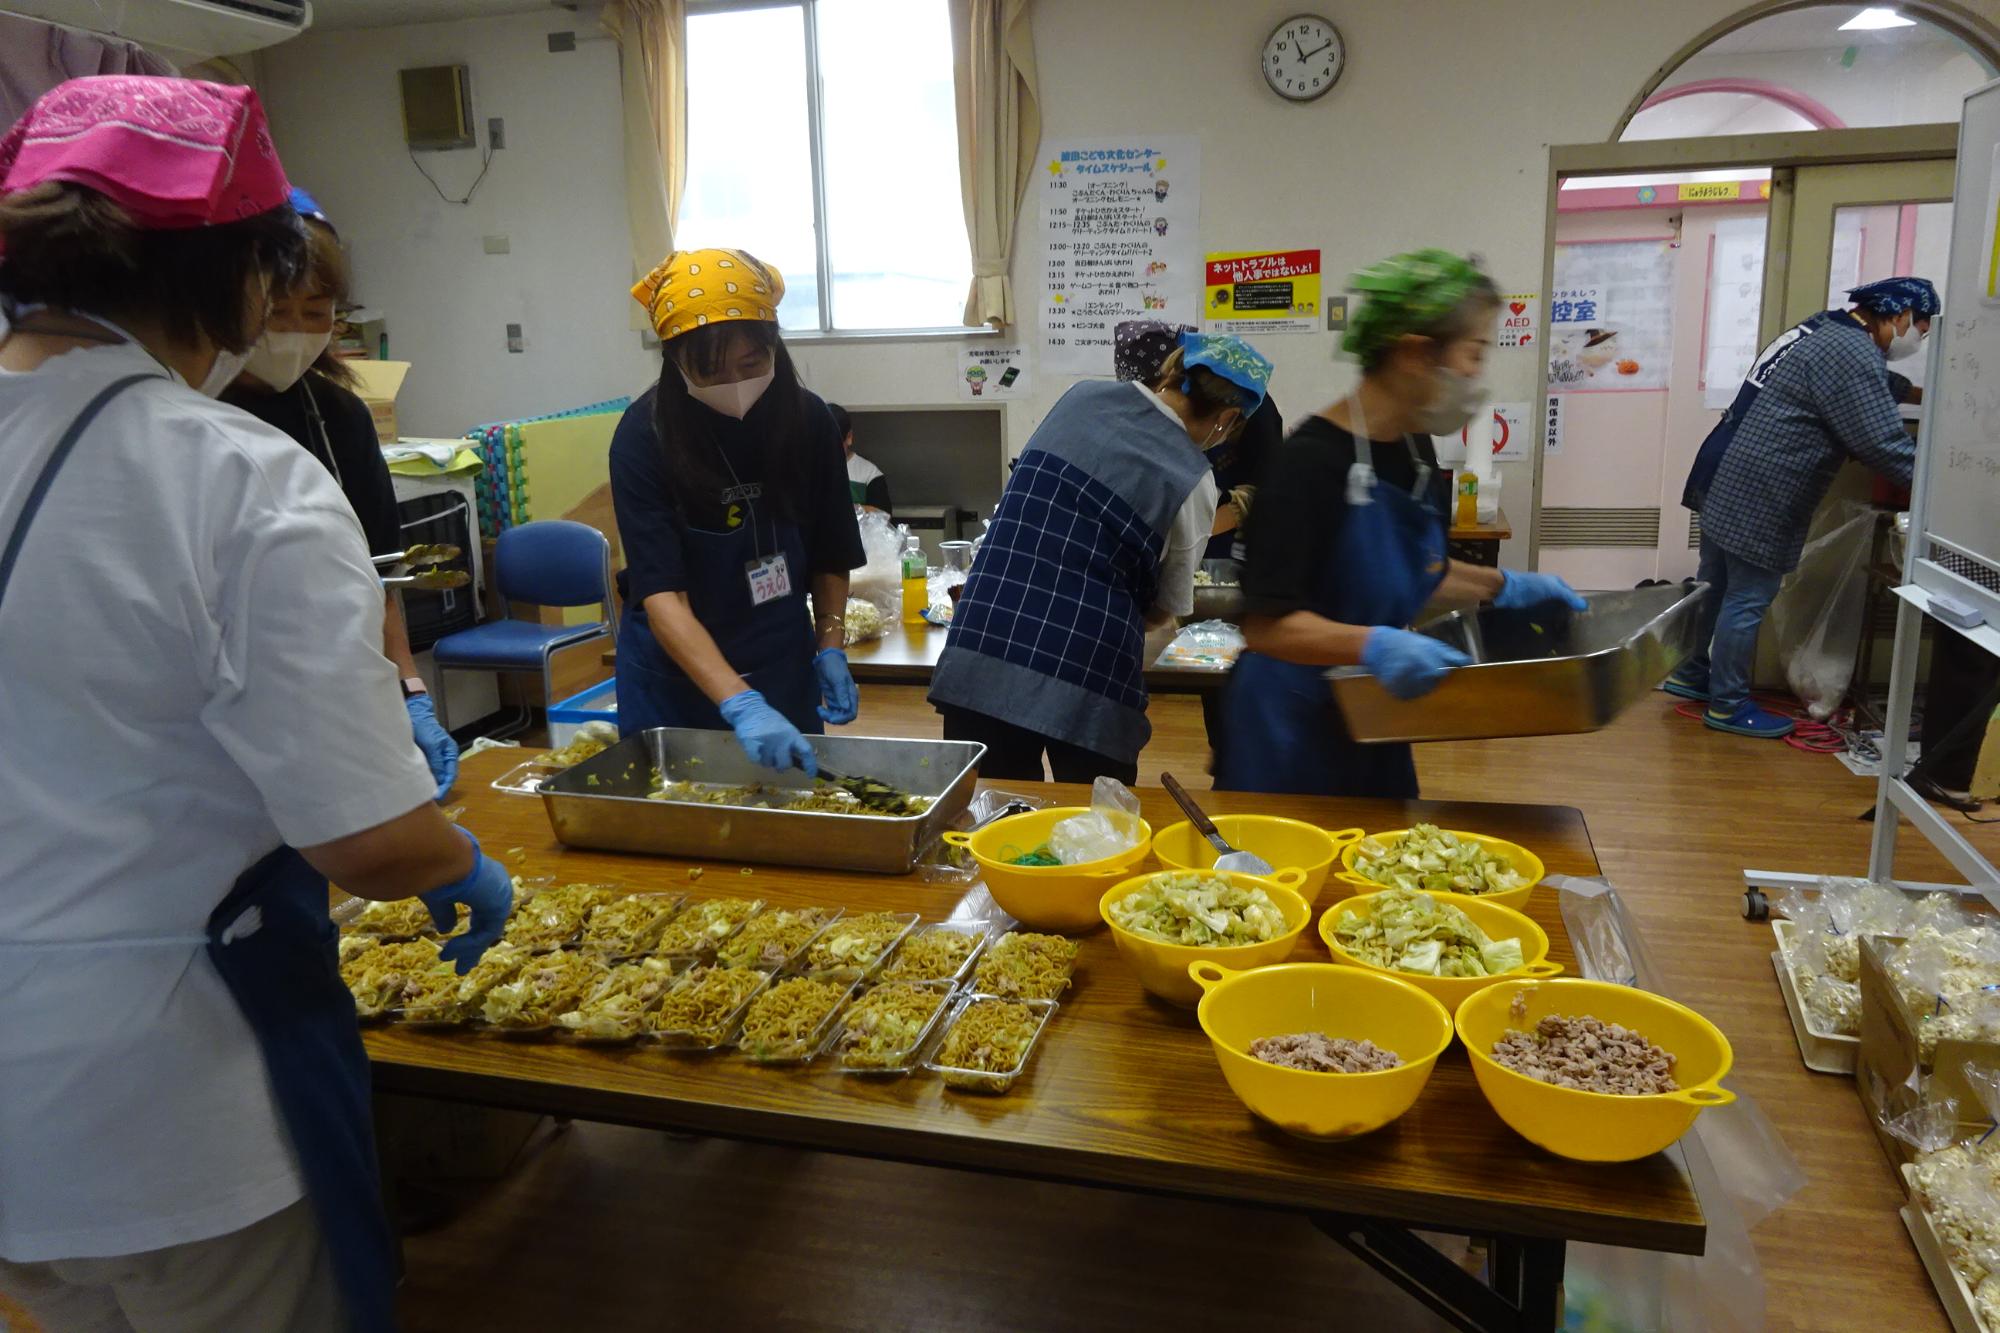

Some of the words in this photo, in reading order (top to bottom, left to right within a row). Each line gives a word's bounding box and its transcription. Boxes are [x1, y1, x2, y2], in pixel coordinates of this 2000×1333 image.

[1287, 30, 1295, 40] 11
[1300, 25, 1310, 35] 12
[1316, 29, 1321, 38] 1
[1276, 42, 1287, 52] 10
[1272, 55, 1279, 64] 9
[1328, 53, 1335, 62] 3
[1275, 69, 1282, 79] 8
[1323, 68, 1330, 77] 4
[1286, 79, 1293, 89] 7
[1298, 82, 1305, 91] 6
[1313, 78, 1319, 87] 5
[1076, 163, 1151, 174] タイムスケジュール
[1050, 181, 1067, 189] 11:30
[1213, 256, 1286, 274] ネットトラブルは
[1232, 262, 1312, 283] 他人事ではないよ!
[1551, 299, 1597, 323] 控室
[1505, 317, 1530, 328] AED
[1548, 398, 1559, 446] 関係者以外
